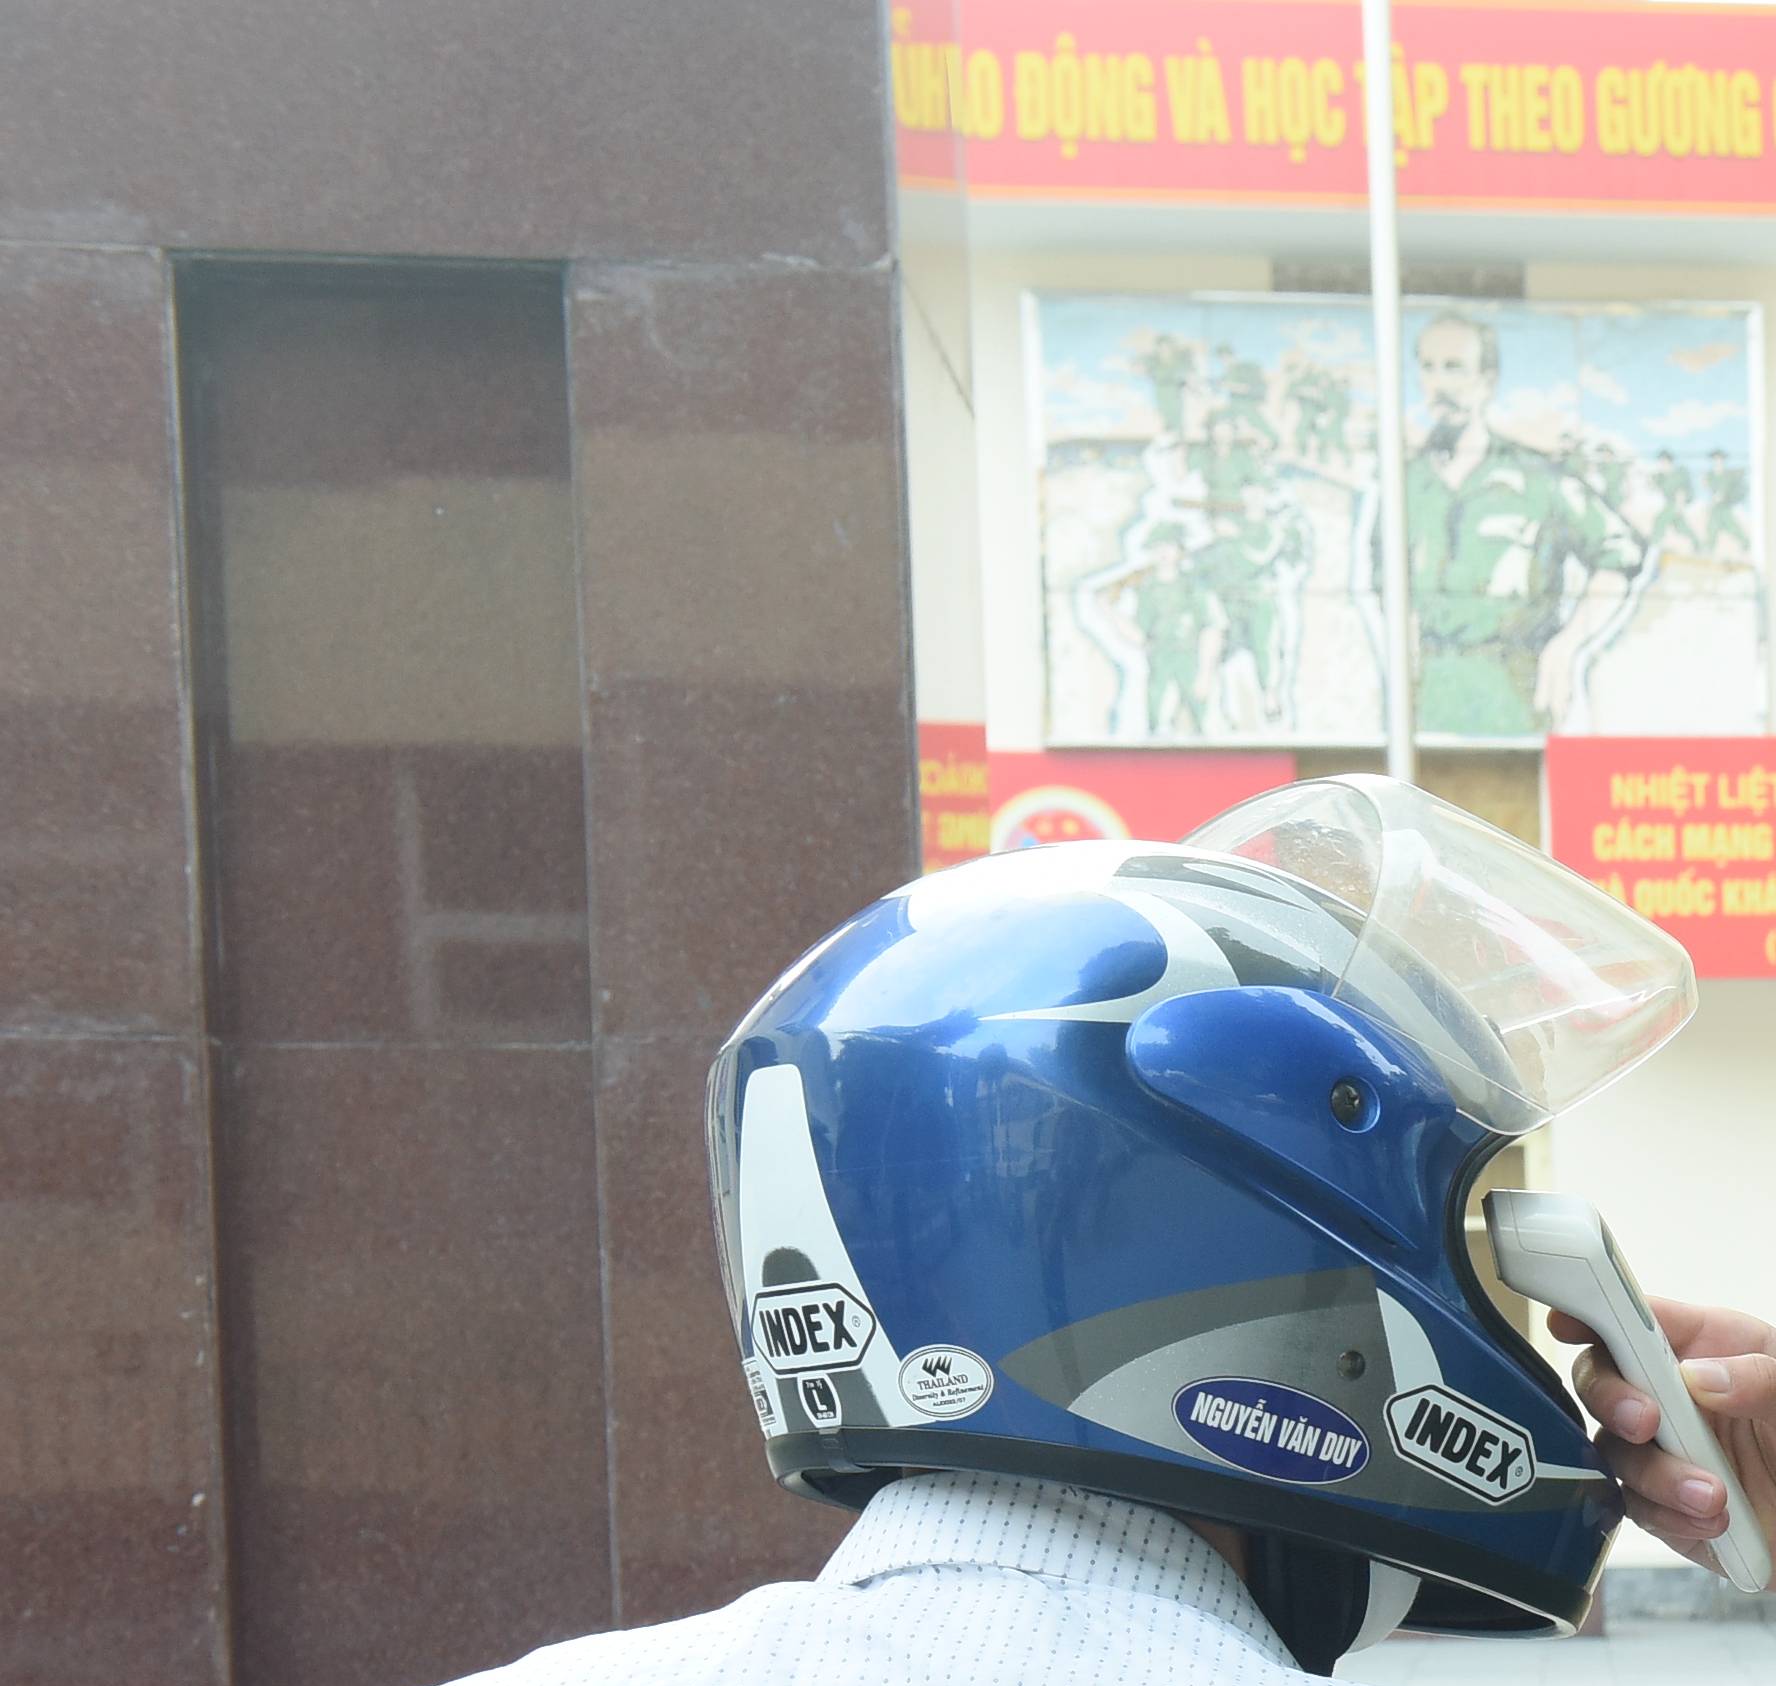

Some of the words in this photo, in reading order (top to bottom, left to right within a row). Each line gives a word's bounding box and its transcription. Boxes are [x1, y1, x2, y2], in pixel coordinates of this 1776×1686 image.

[1014, 31, 1157, 159] ĐỘNG
[1165, 39, 1231, 143] VÀ
[1243, 58, 1346, 163] HỌC
[1462, 64, 1583, 152] THEO
[1597, 60, 1763, 157] GƯƠNG
[1611, 764, 1708, 815] NHIỆT
[1594, 818, 1675, 861] CÁCH
[1683, 822, 1773, 868] MẠNG
[1634, 869, 1715, 920] QUỐC
[759, 1300, 857, 1358] INDEX
[812, 1389, 828, 1411] L
[917, 1374, 968, 1391] THAILAND
[1190, 1391, 1275, 1444] NGUYỄN
[1277, 1416, 1319, 1456] VĂN
[1319, 1433, 1363, 1469] DUY
[1405, 1398, 1523, 1490] INDEX
